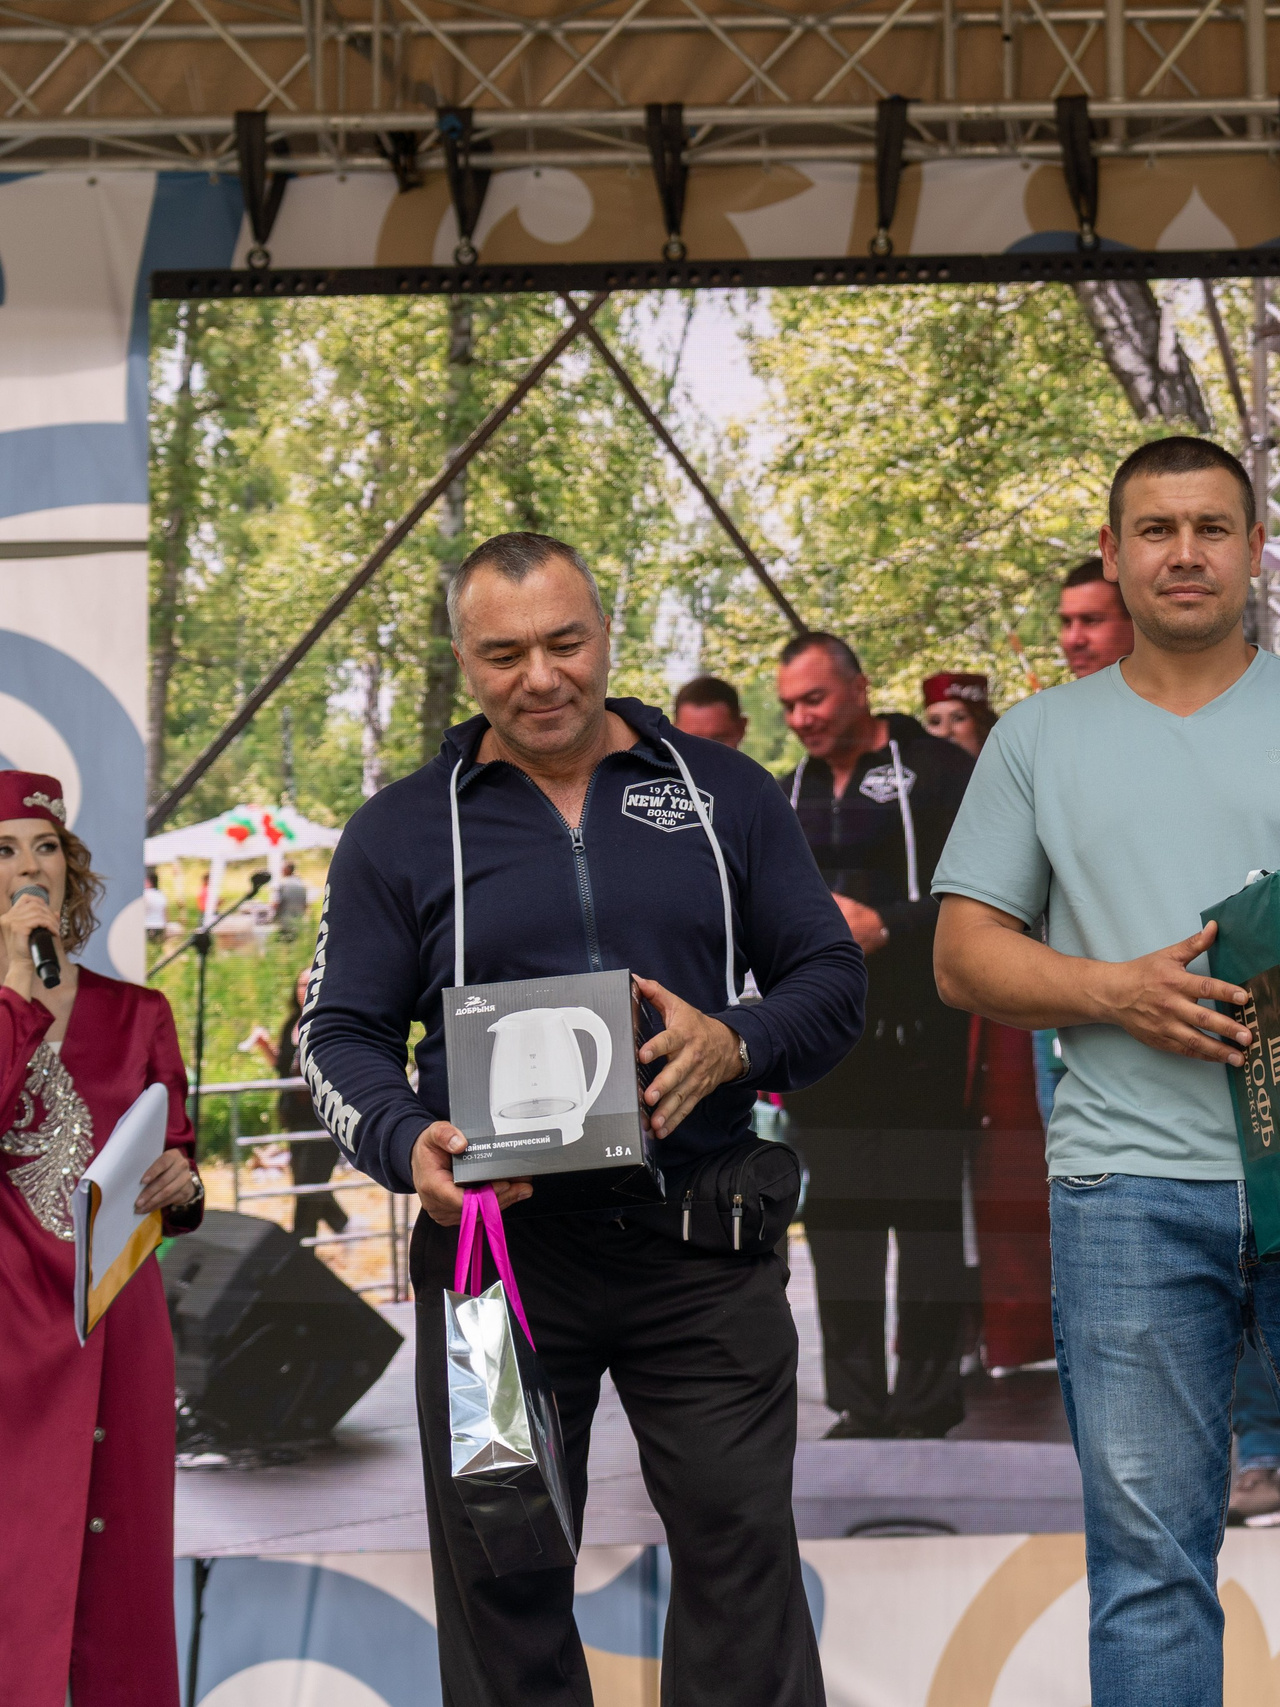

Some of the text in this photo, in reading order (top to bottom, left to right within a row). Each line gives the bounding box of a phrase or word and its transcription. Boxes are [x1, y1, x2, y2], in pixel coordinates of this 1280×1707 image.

[627, 794, 666, 808] NEW
[647, 808, 686, 820] BOXING
[656, 817, 676, 826] Club
[455, 1004, 496, 1016] ДОБРЫНЯ
[492, 1136, 551, 1149] электрический
[605, 1145, 622, 1158] 1.8
